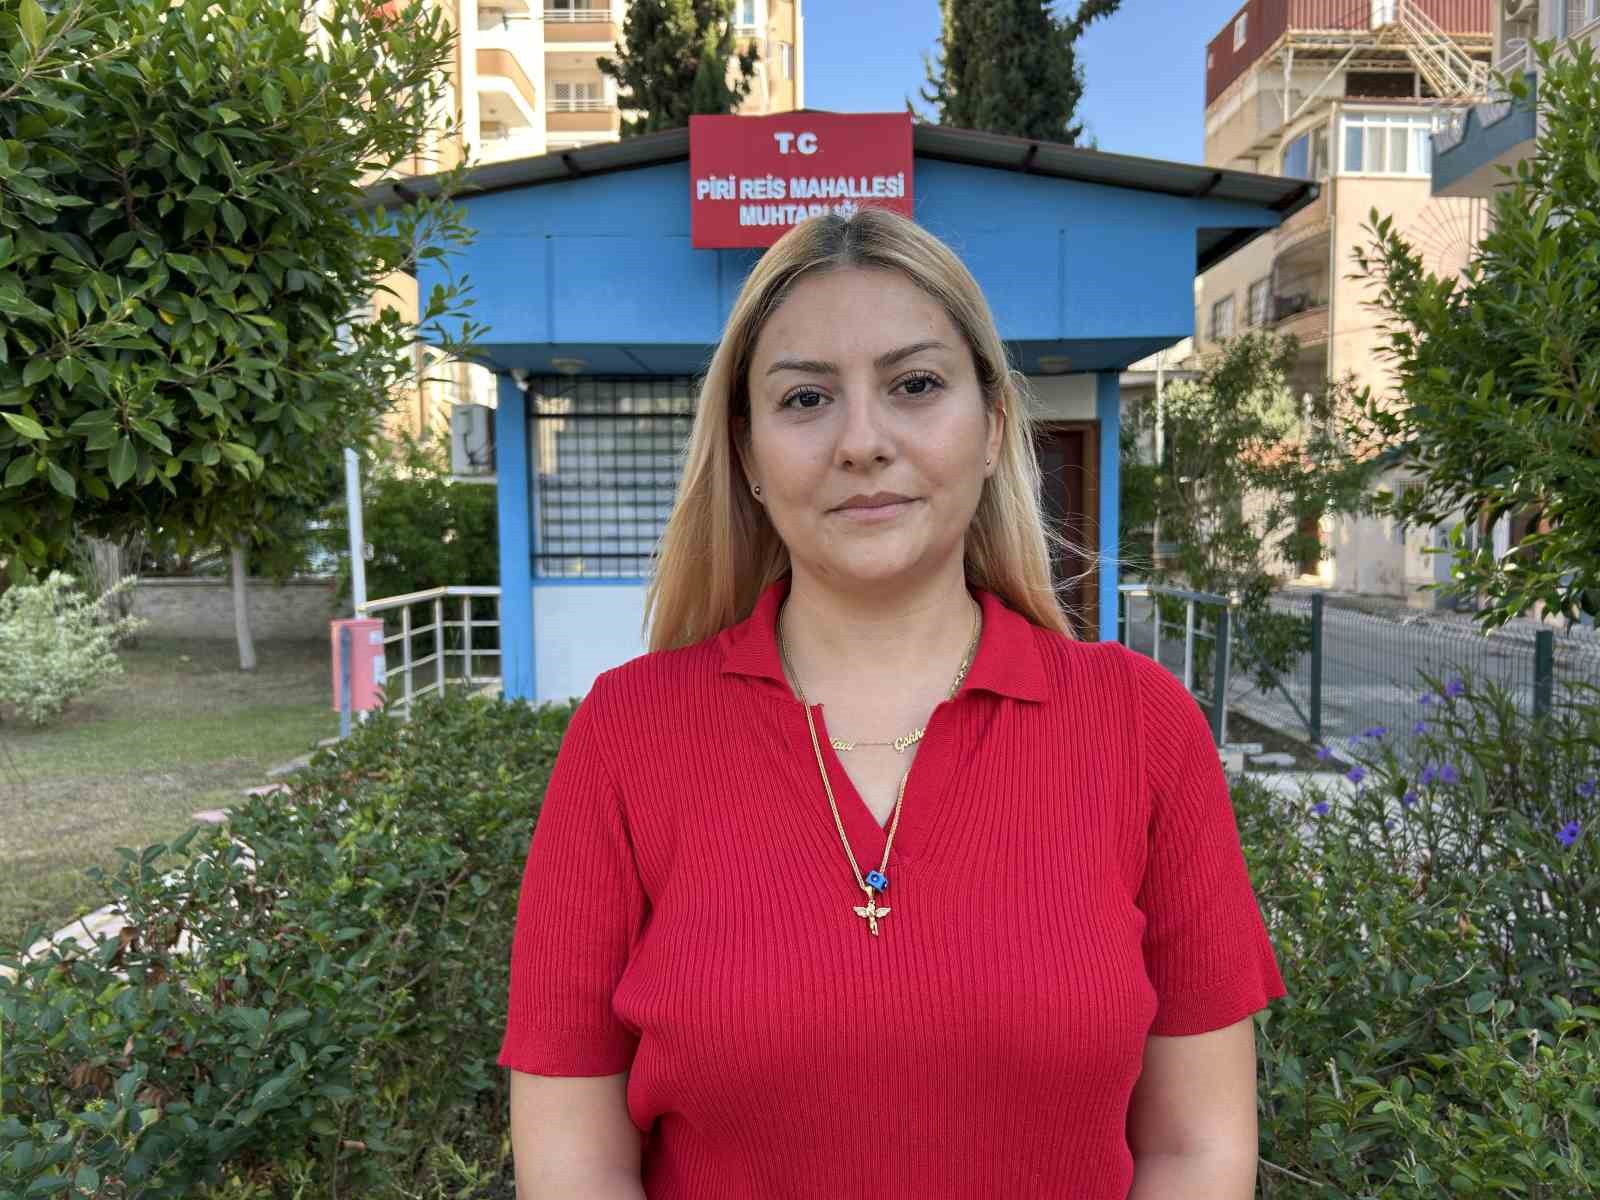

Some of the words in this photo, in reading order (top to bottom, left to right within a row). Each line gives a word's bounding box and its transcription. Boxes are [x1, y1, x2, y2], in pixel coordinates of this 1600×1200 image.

[696, 173, 736, 200] PİRİ
[740, 173, 786, 199] REİS
[790, 172, 905, 198] MAHALLESİ
